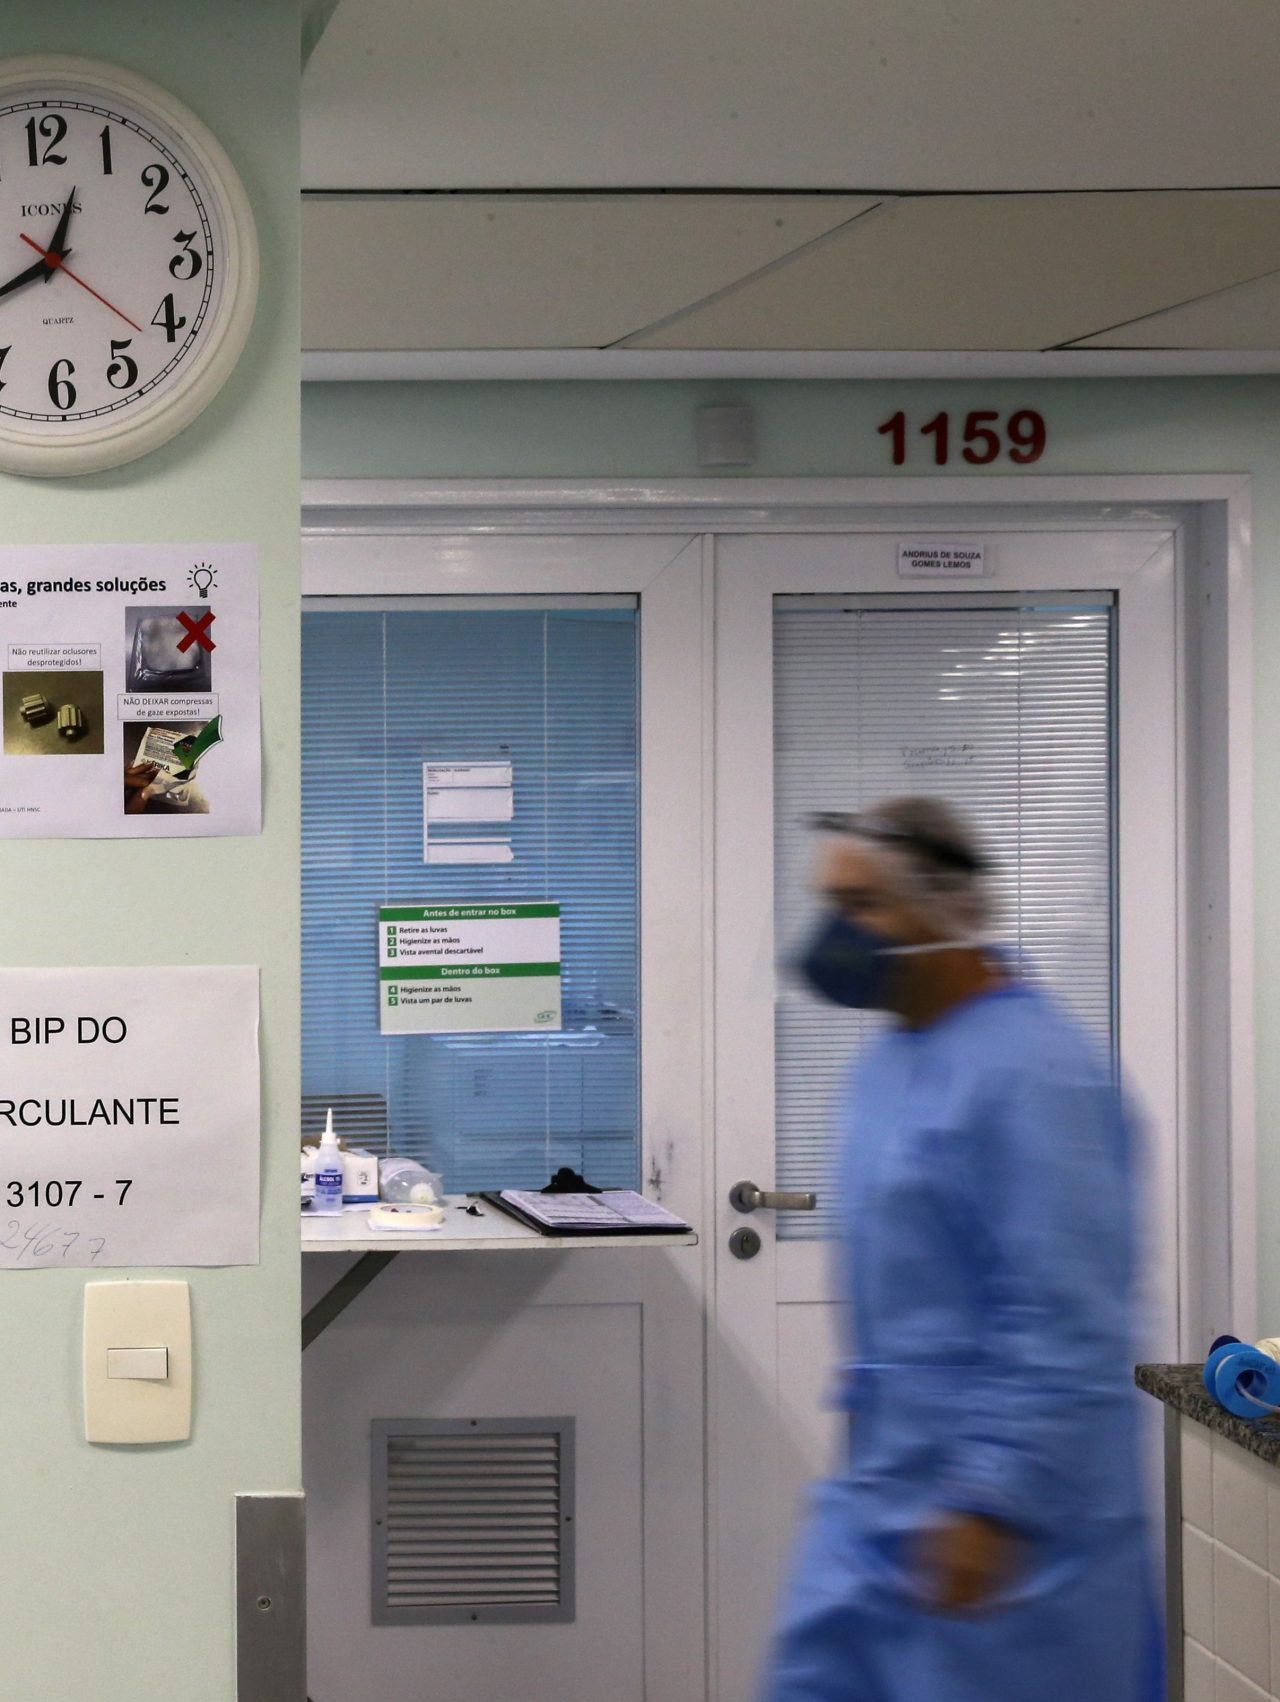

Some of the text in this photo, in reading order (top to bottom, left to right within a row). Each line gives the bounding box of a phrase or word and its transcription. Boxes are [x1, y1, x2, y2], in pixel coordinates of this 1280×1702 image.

[24, 113, 68, 167] 12
[98, 124, 113, 175] 1
[140, 163, 170, 216] 2
[21, 202, 82, 217] ICONS
[168, 228, 203, 280] 3
[42, 316, 75, 326] QUARTZ
[150, 292, 187, 343] 4
[106, 338, 139, 390] 5
[47, 357, 78, 410] 6
[877, 409, 1047, 466] 1159
[902, 550, 982, 560] ANDRIUS DE SOUZA
[911, 559, 971, 569] GOMES LEMOS
[26, 577, 92, 596] grandes
[95, 576, 167, 595] soluções
[11, 647, 97, 656] Não reutilizar oclusores
[27, 658, 82, 667] desprotegidos!
[123, 697, 213, 706] NÃO DEIXAR compressas
[136, 708, 200, 717] de gaze expostas!
[423, 909, 447, 917] Antes
[448, 908, 459, 917] de
[460, 908, 486, 917] entrar
[500, 907, 516, 916] box
[399, 926, 420, 934] Retire
[399, 938, 432, 946] Higienize
[399, 948, 417, 956] Vista
[417, 947, 443, 955] avental
[444, 946, 484, 955] descartável
[441, 966, 500, 976] Dentro do box
[400, 986, 433, 995] Higienize
[400, 997, 418, 1005] Vista
[431, 998, 443, 1006] par
[443, 996, 453, 1004] de
[10, 1015, 128, 1045] BIP DO
[6, 1180, 84, 1208] 3107
[114, 1179, 134, 1207] 7
